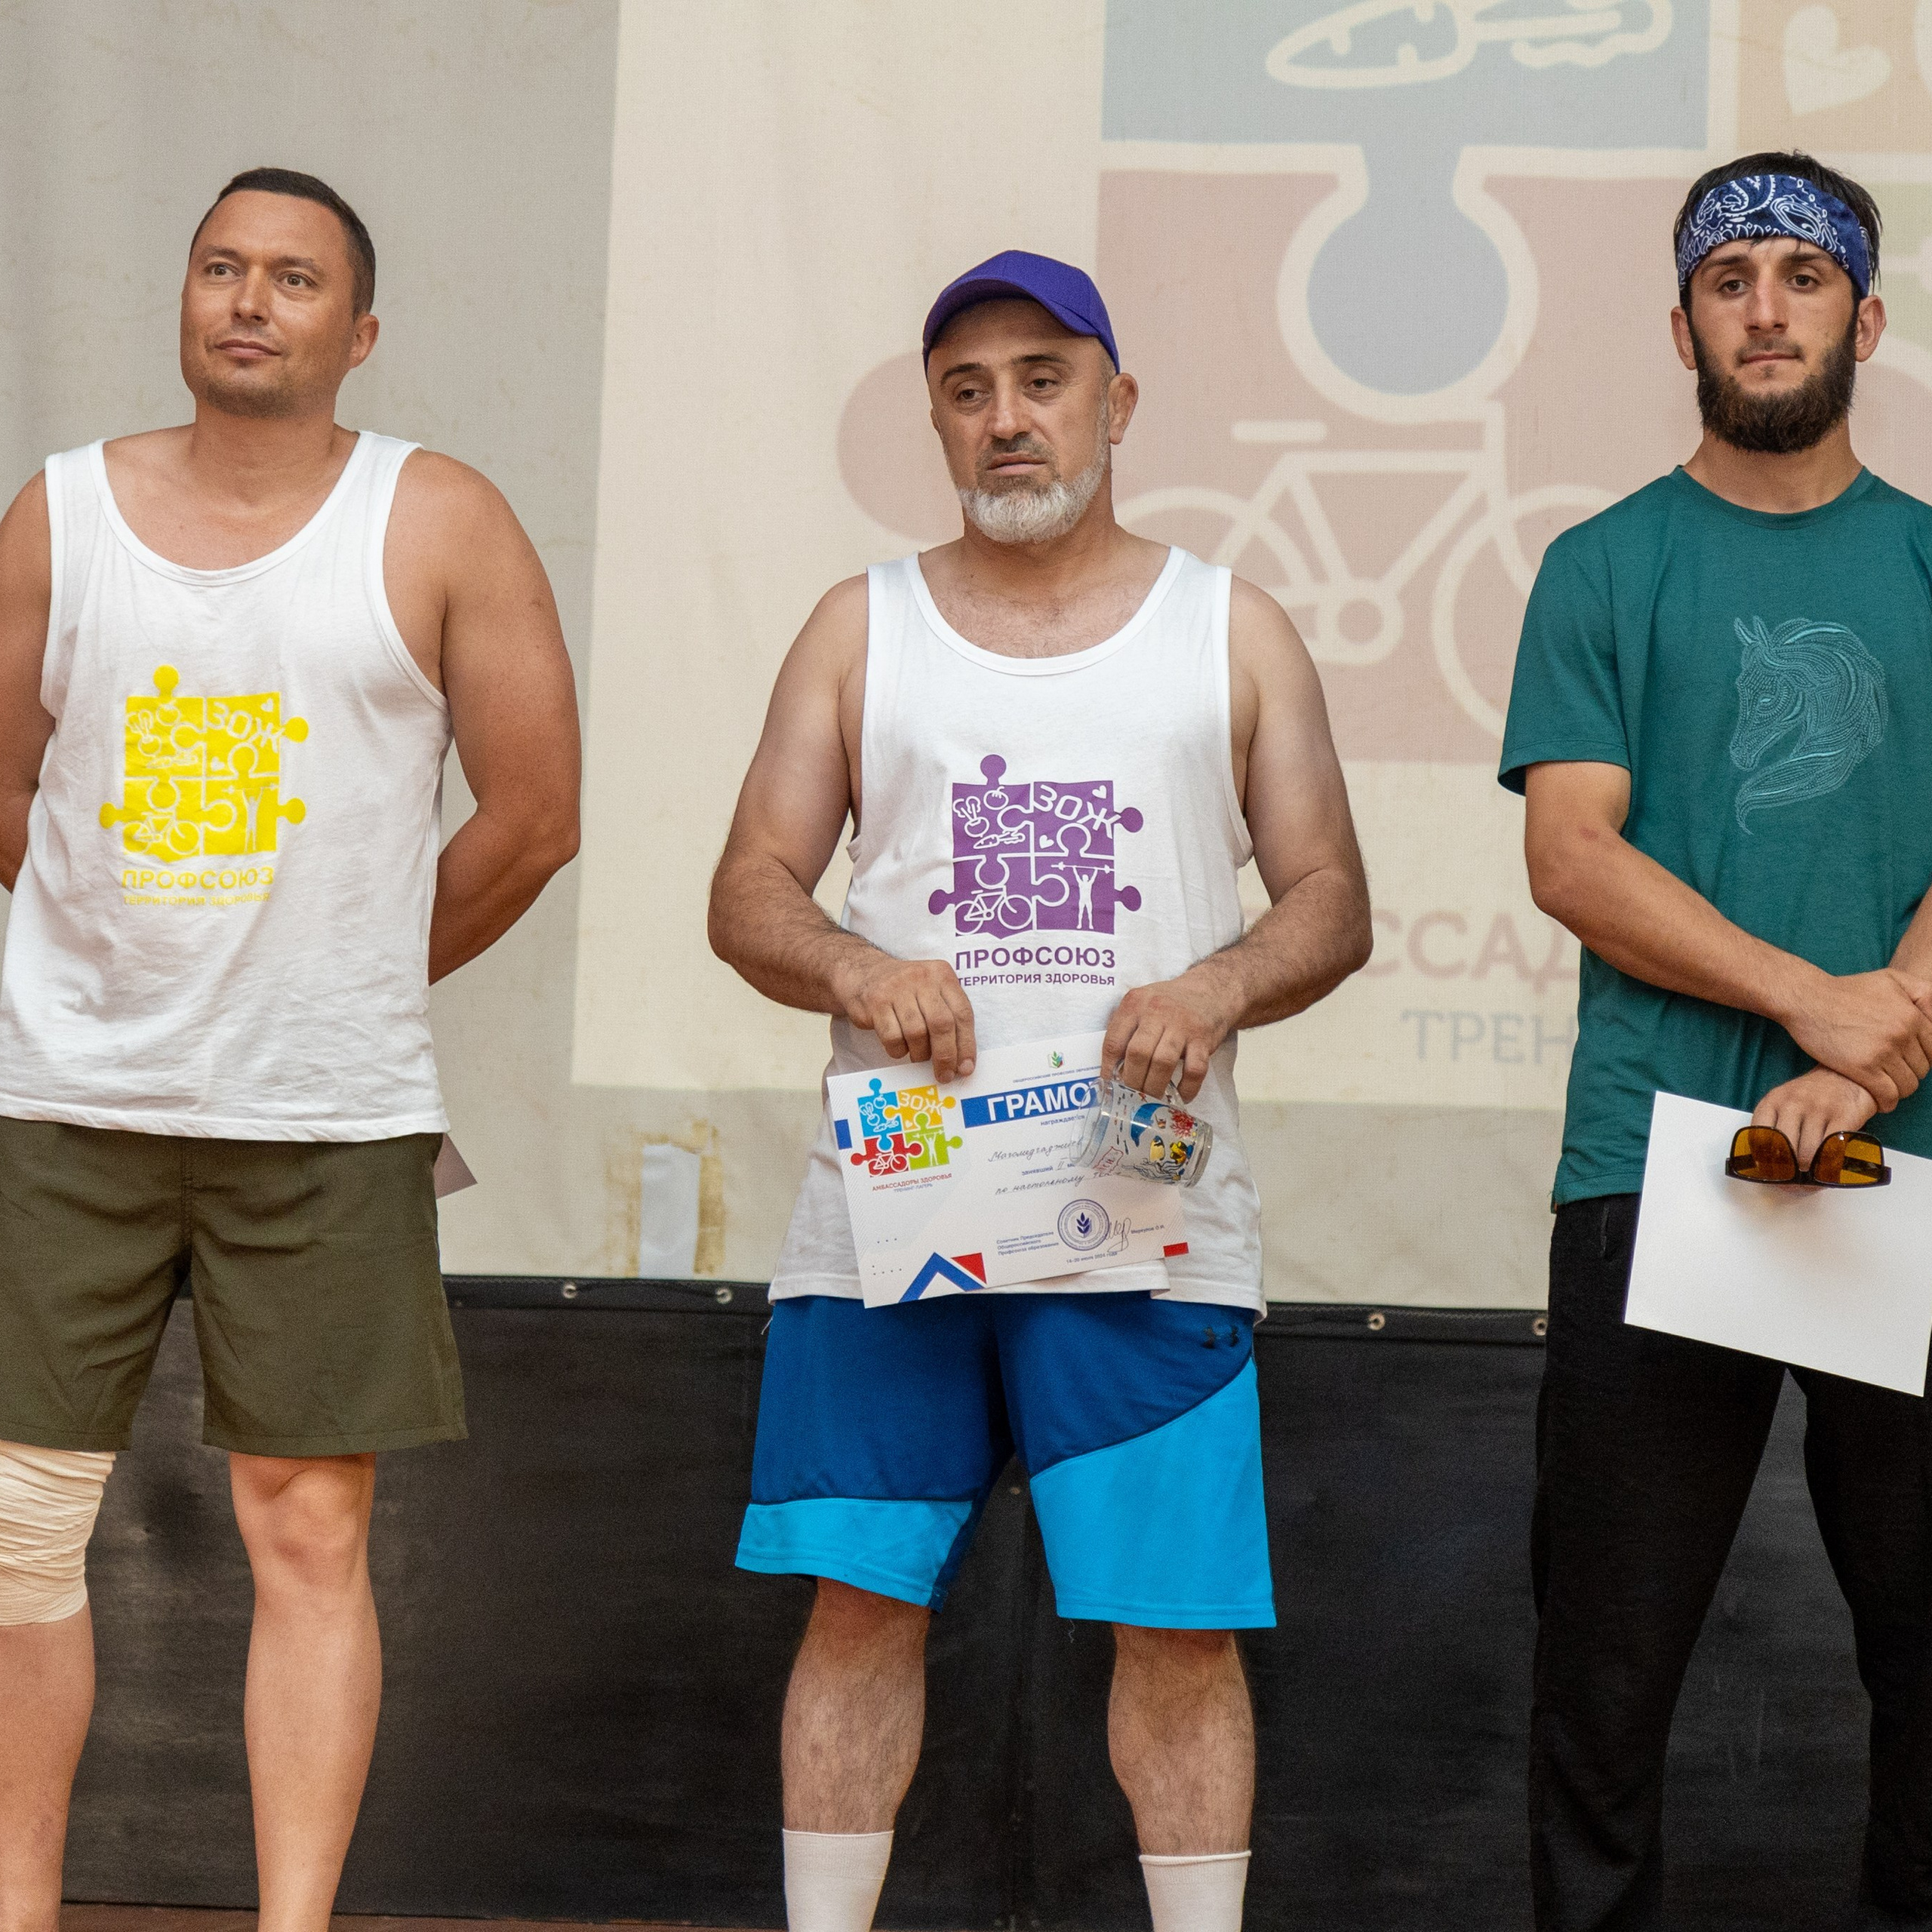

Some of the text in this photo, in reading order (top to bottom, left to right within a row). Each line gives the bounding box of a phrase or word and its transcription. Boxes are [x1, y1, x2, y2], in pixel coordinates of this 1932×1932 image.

[206, 701, 286, 754] ЗОЖ
[1033, 784, 1121, 839] ЗОЖ
[122, 866, 275, 889] ПРОФСОЮЗ
[123, 894, 205, 906] ТЕРРИТОРИЯ
[955, 946, 1115, 971] ПРОФСОЮЗ
[958, 973, 1115, 987] ТЕРРИТОРИЯ ЗДОРОВЬЯ
[900, 1091, 943, 1115] ЗОЖ
[1021, 1165, 1054, 1176] занявший
[872, 1173, 952, 1192] АМБАССАДОРЫ ЗДОРОВЬЯ
